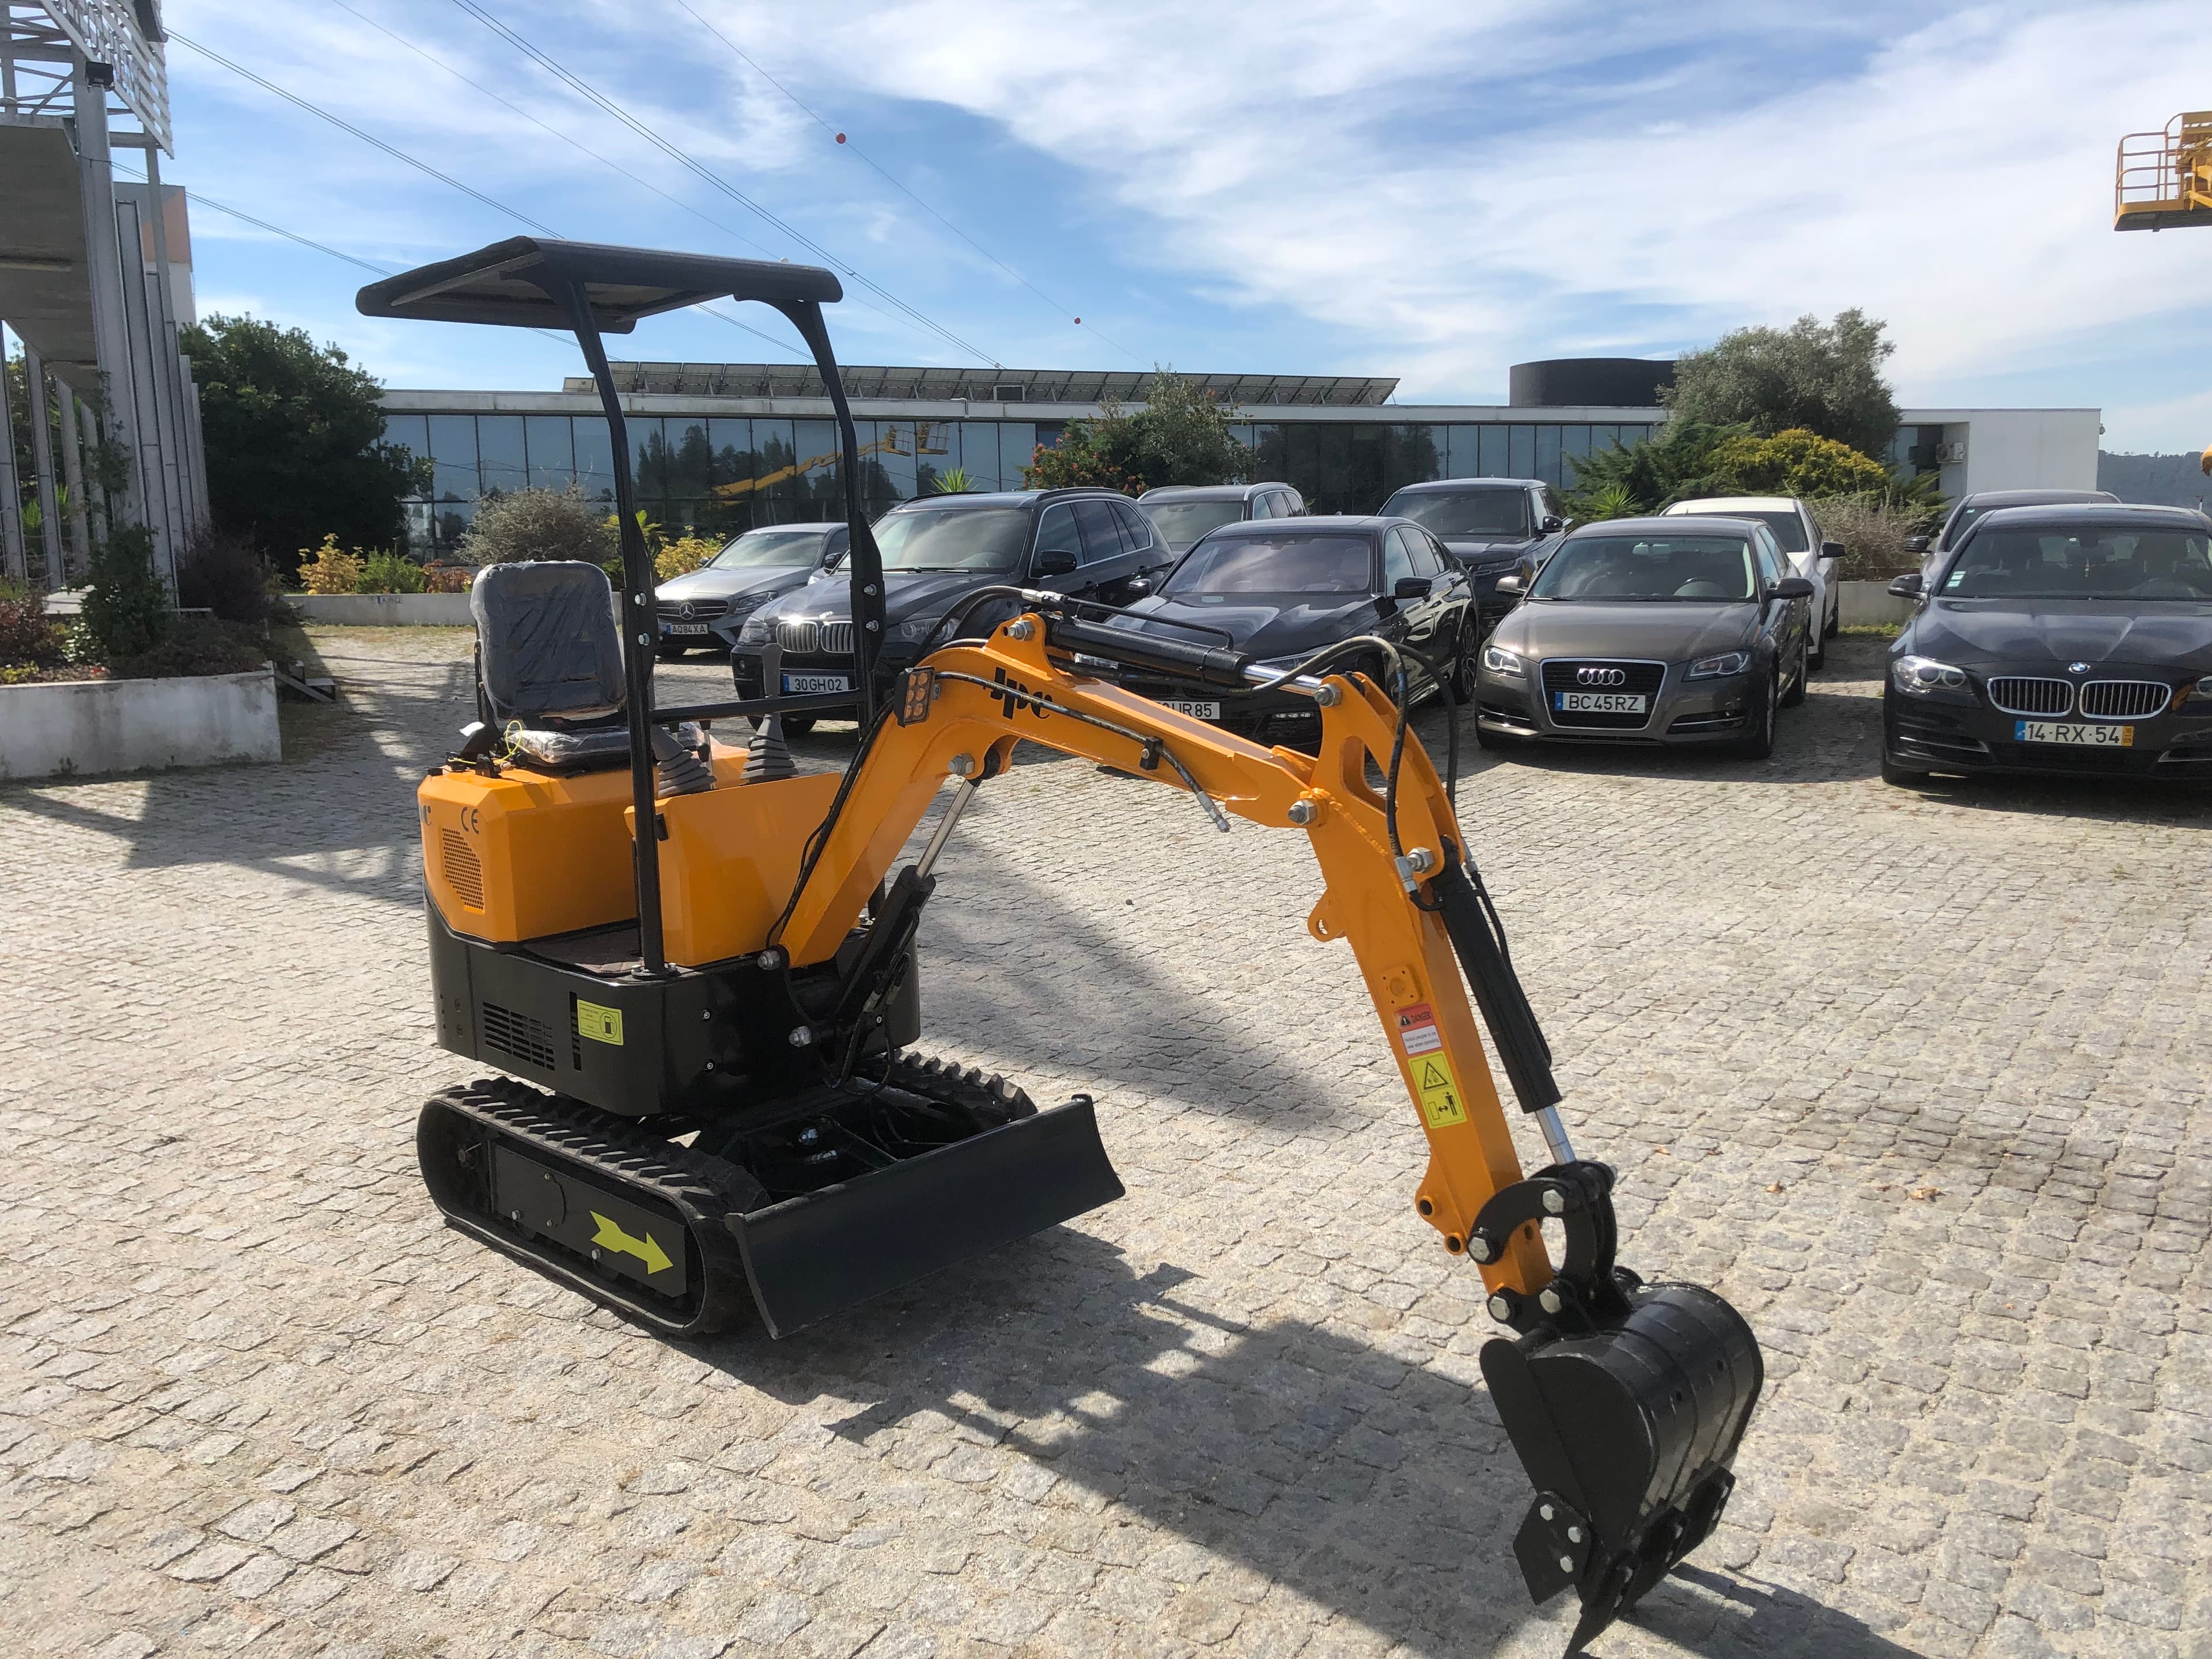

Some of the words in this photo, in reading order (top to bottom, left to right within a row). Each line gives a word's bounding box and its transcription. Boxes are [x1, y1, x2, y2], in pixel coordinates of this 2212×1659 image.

[794, 678, 842, 691] 30GH02
[1569, 695, 1638, 711] BC45RZ
[1410, 1011, 1431, 1024] DANGER
